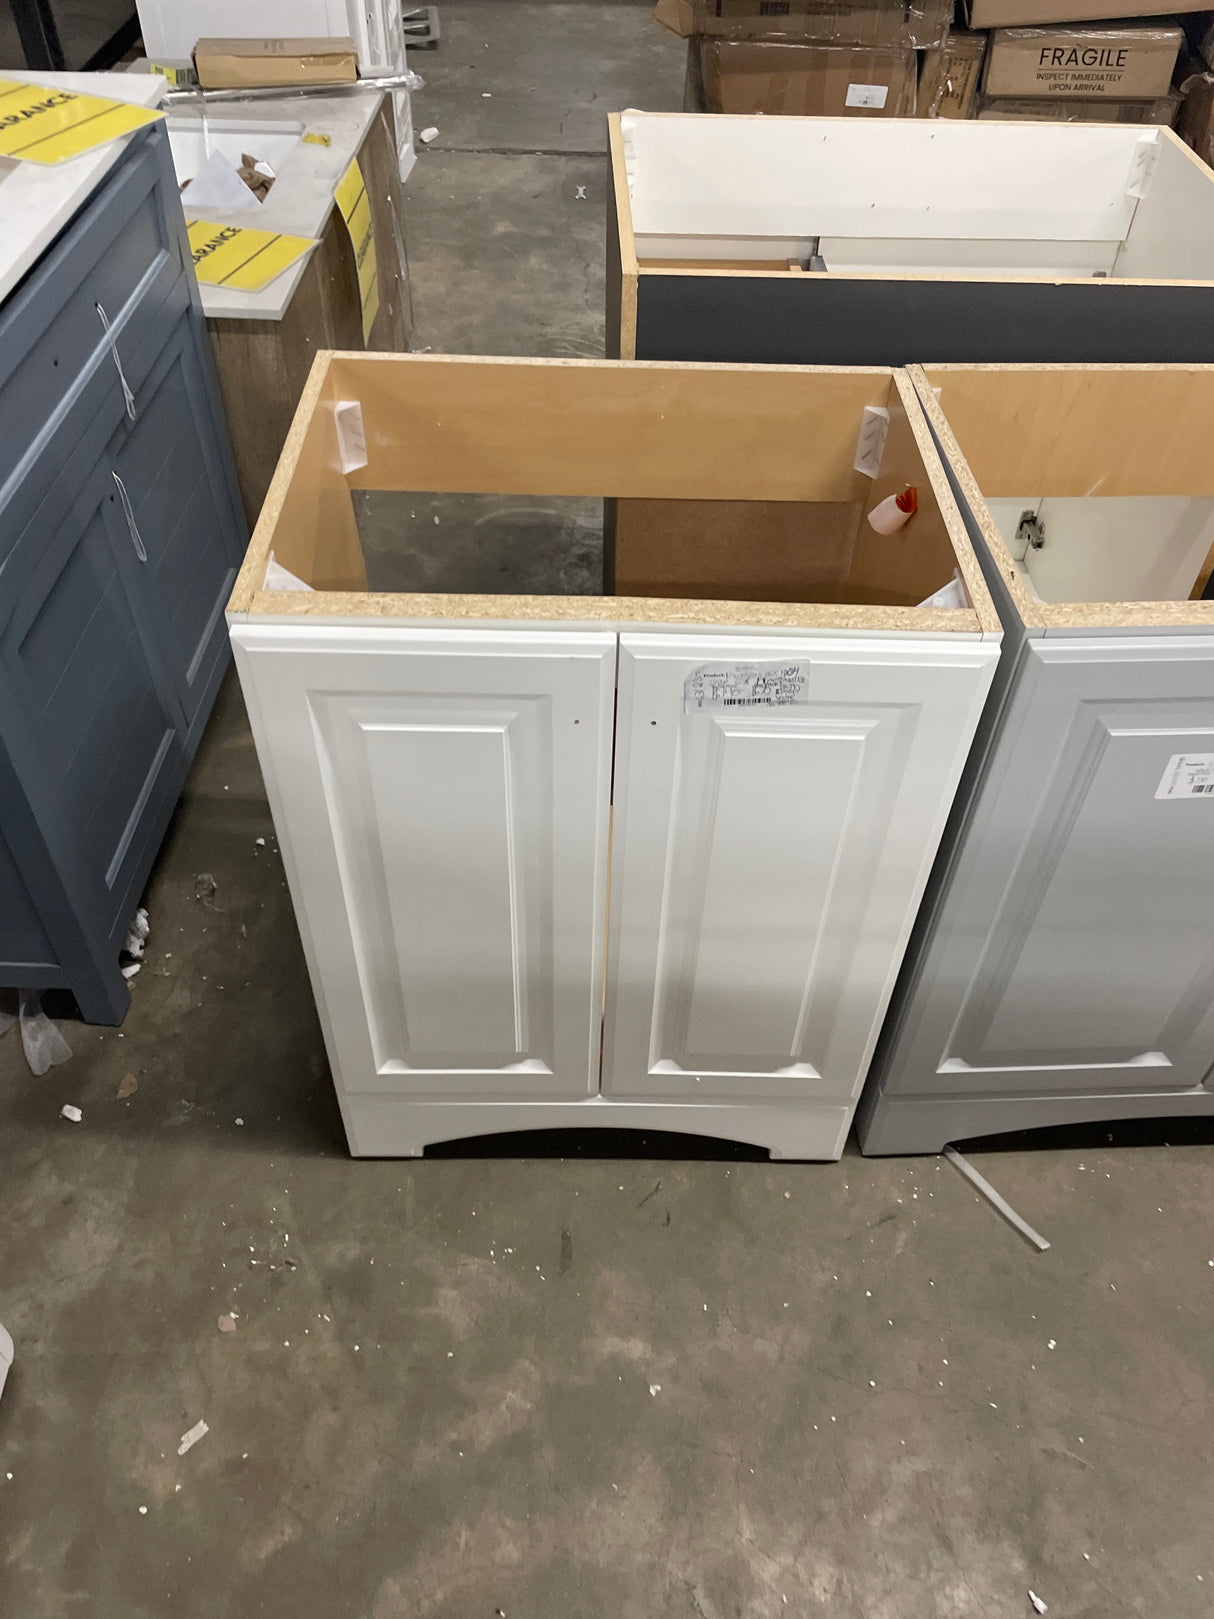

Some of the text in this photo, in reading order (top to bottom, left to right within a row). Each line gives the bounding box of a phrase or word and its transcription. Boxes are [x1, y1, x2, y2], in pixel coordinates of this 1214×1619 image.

[1039, 47, 1129, 67] FRAGILE
[1036, 72, 1123, 82] INSPECT IMMEDIATELY
[1048, 83, 1105, 92] UPON ARRIVAL
